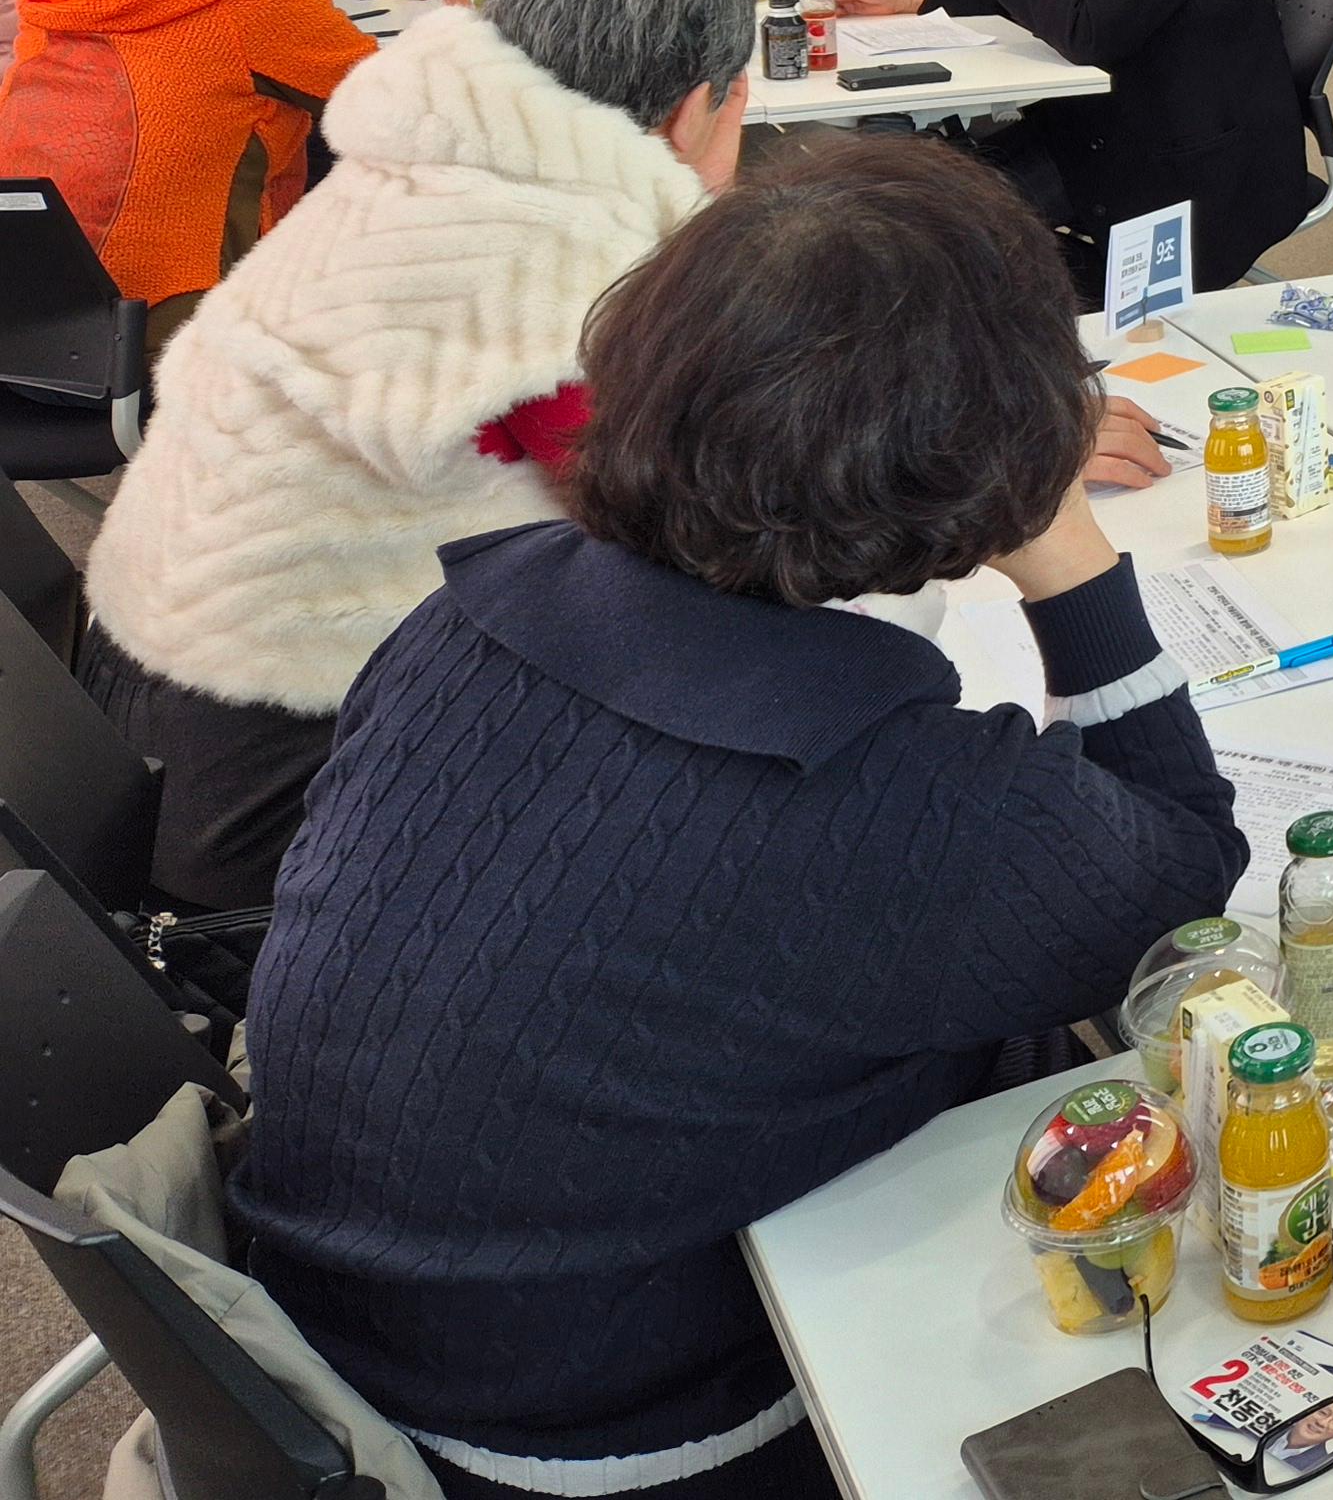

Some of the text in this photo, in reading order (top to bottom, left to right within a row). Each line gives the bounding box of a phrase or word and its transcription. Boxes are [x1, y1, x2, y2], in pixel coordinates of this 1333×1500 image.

[1156, 237, 1176, 265] 9조
[1082, 1098, 1104, 1115] 과일
[1093, 1087, 1120, 1110] 굿모닝
[1190, 1360, 1249, 1399] 2
[1213, 1387, 1281, 1436] 천동현
